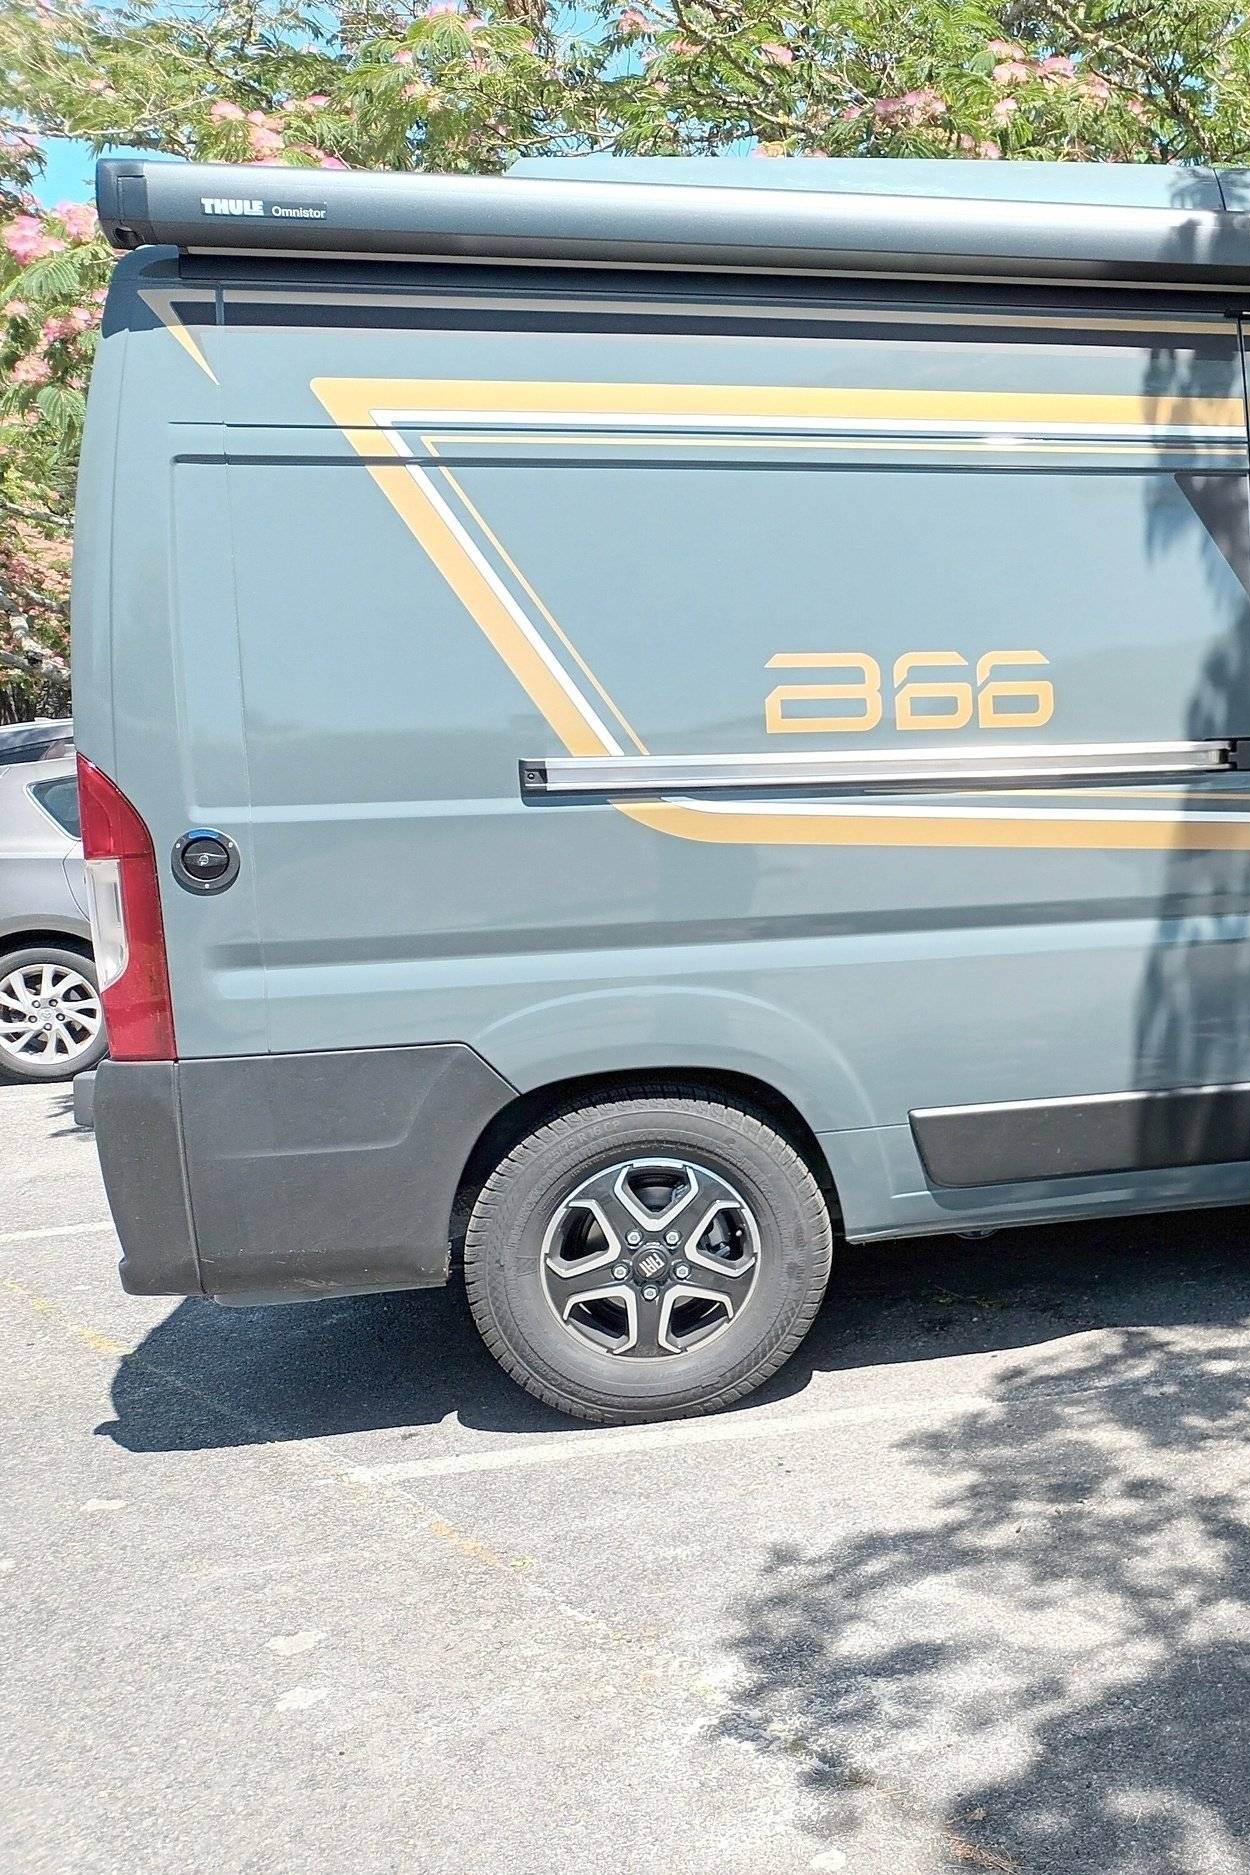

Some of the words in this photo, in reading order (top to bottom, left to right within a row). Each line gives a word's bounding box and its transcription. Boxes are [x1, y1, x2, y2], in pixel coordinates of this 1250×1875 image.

[201, 197, 265, 216] THULE
[271, 205, 326, 219] Omnistor
[638, 1252, 665, 1277] FIAT
